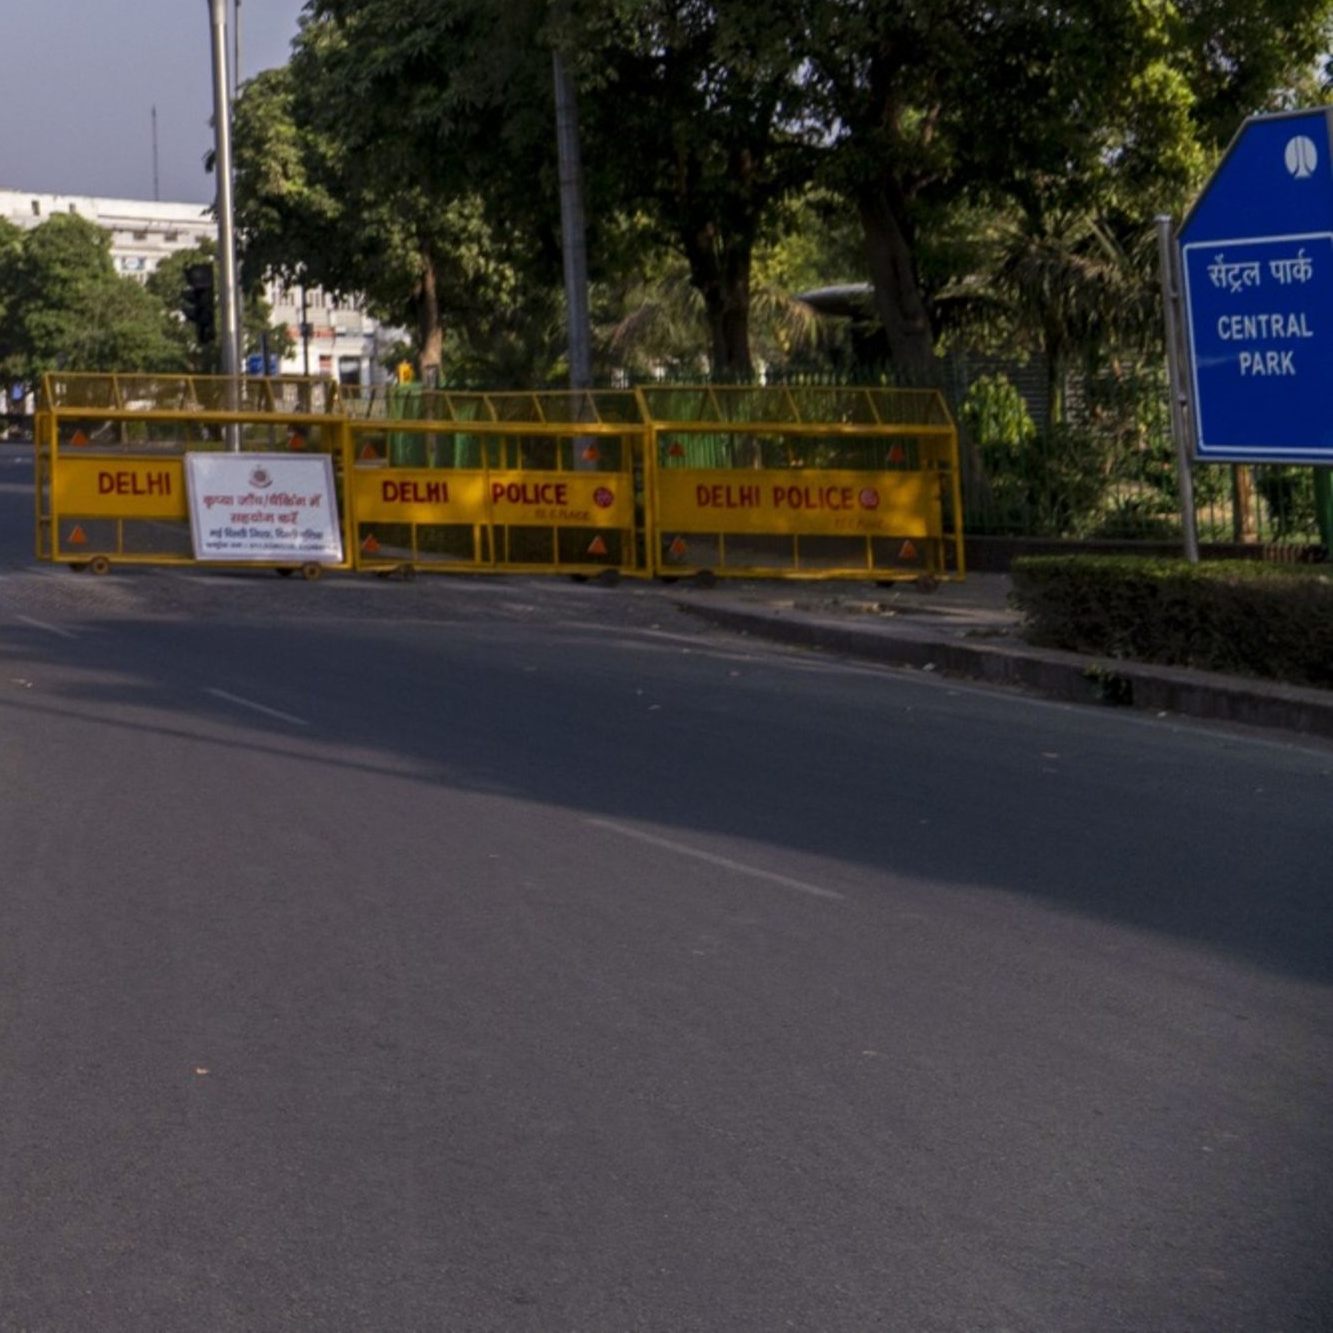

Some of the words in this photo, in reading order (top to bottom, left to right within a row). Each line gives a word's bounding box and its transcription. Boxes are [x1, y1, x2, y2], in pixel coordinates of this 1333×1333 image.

[1269, 249, 1314, 284] पार्क
[1217, 314, 1314, 341] CENTRAL
[1239, 351, 1296, 376] PARK
[98, 471, 172, 496] DELHI
[382, 481, 449, 503] DELHI
[492, 483, 567, 505] POLICE
[696, 484, 760, 509] DELHI
[772, 486, 853, 510] POLICE
